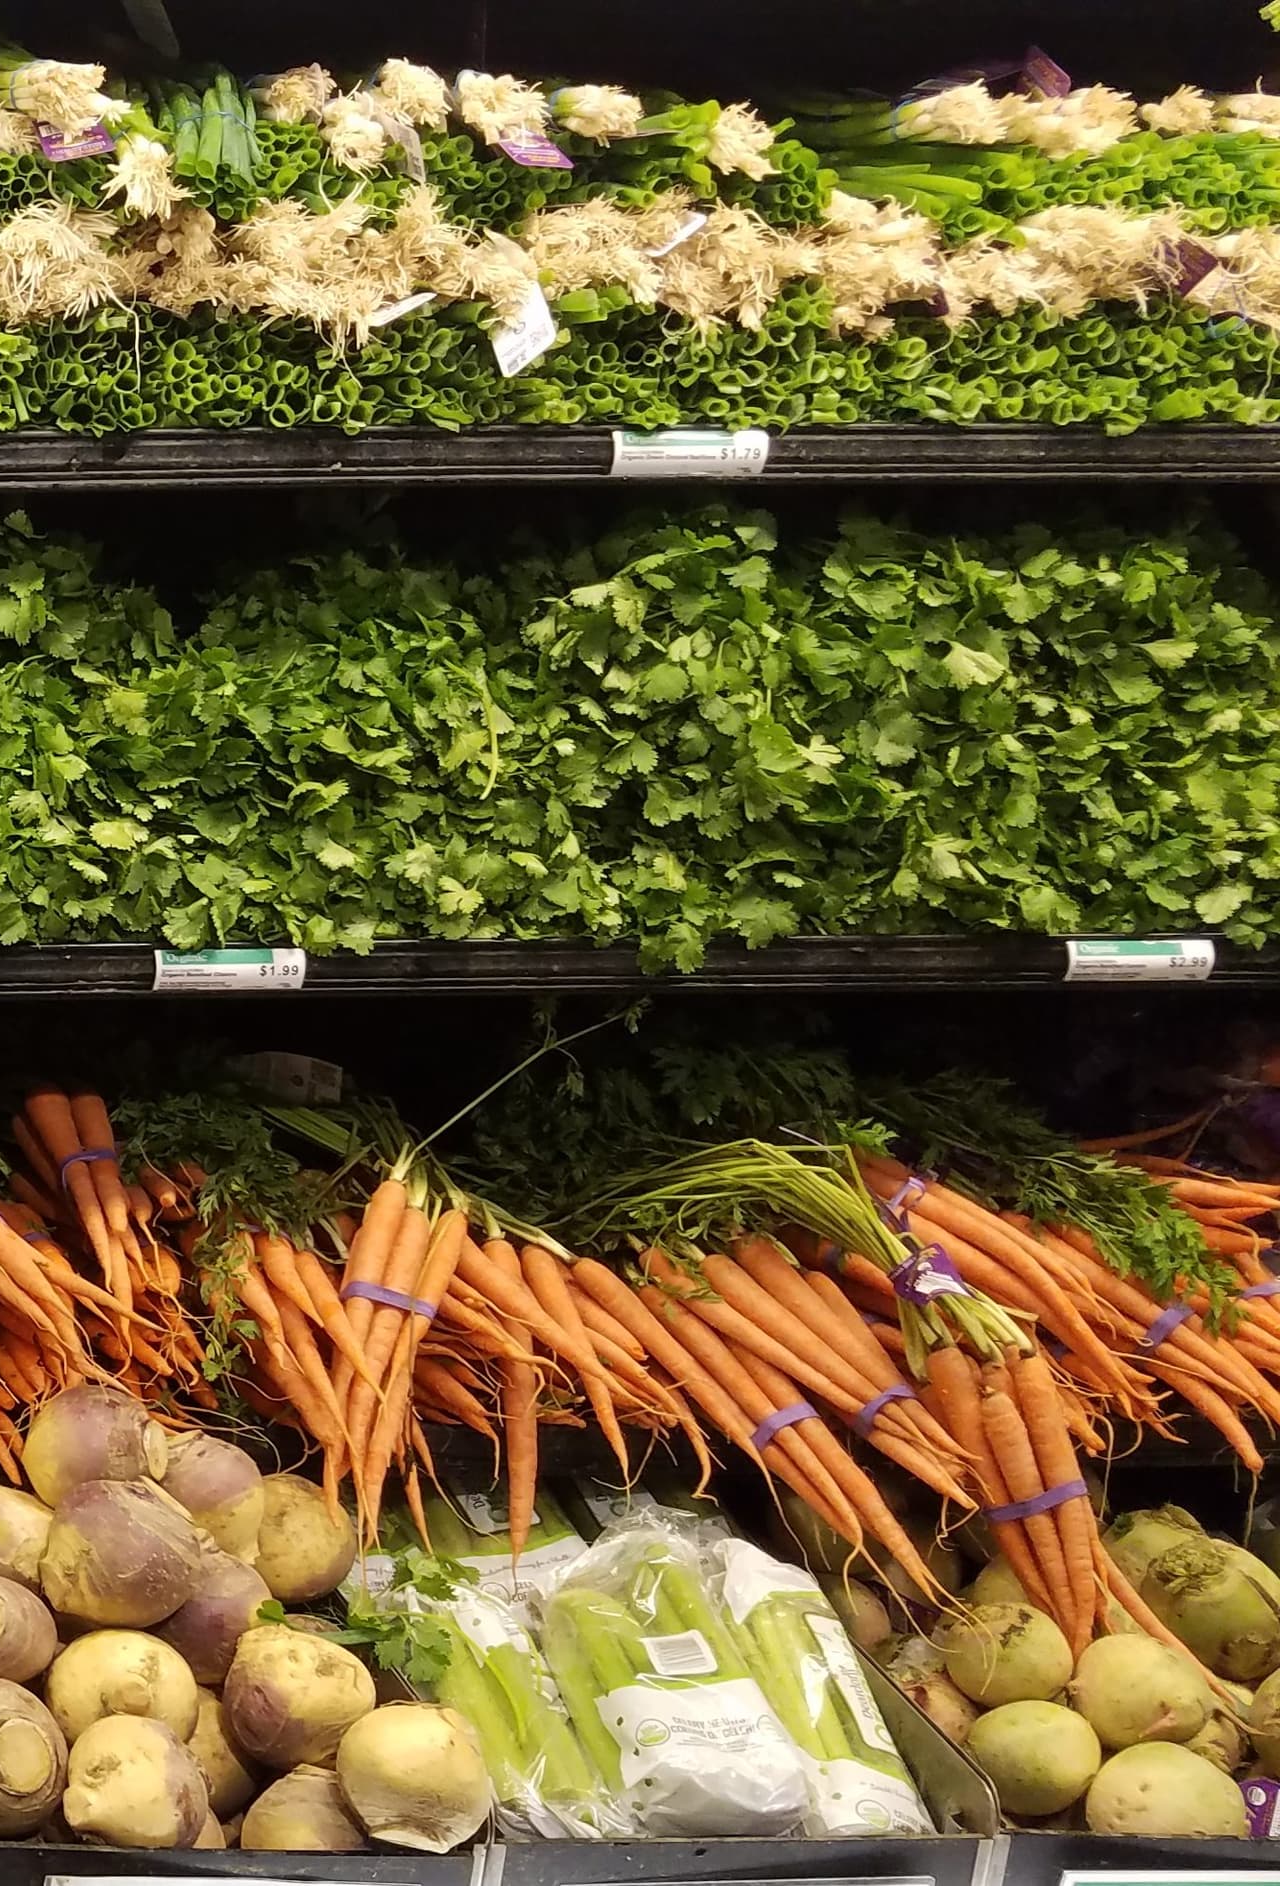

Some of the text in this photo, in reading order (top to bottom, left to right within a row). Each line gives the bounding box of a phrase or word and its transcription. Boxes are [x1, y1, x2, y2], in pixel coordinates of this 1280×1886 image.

[720, 448, 762, 460] $1.79
[1168, 957, 1209, 968] $2.99
[259, 965, 300, 977] $1.99
